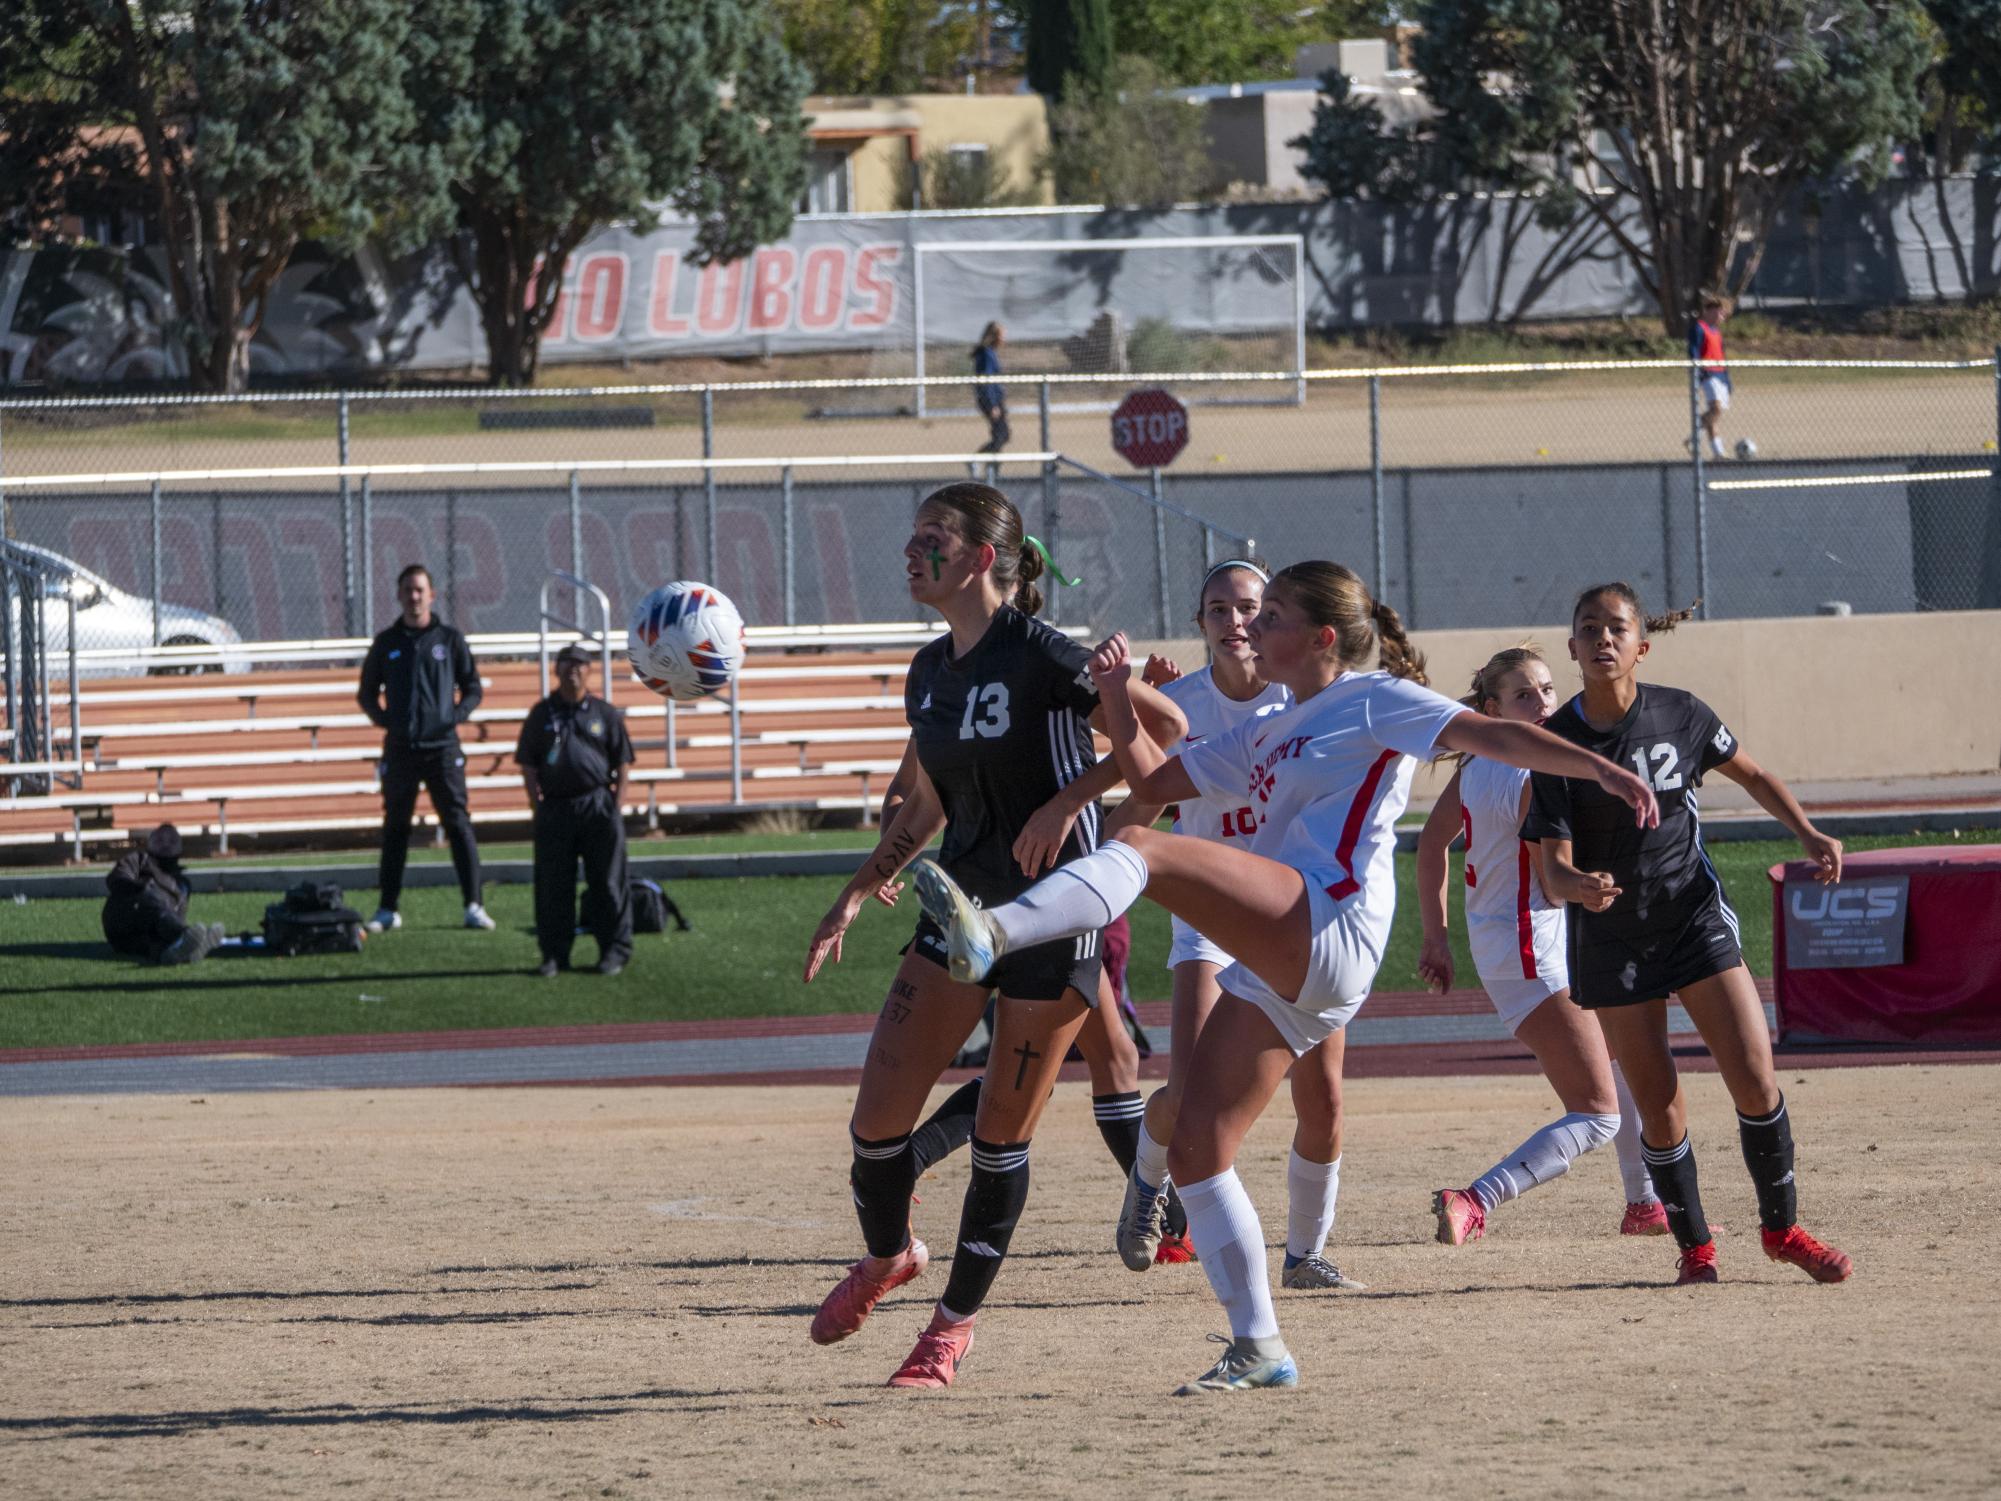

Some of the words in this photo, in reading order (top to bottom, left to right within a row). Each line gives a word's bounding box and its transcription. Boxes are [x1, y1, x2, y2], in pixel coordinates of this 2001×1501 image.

[648, 241, 902, 338] LOBOS
[1113, 411, 1184, 448] STOP
[959, 681, 1010, 740] 13
[1631, 742, 1682, 792] 12
[1222, 806, 1257, 837] 10
[1792, 886, 1899, 920] UCS
